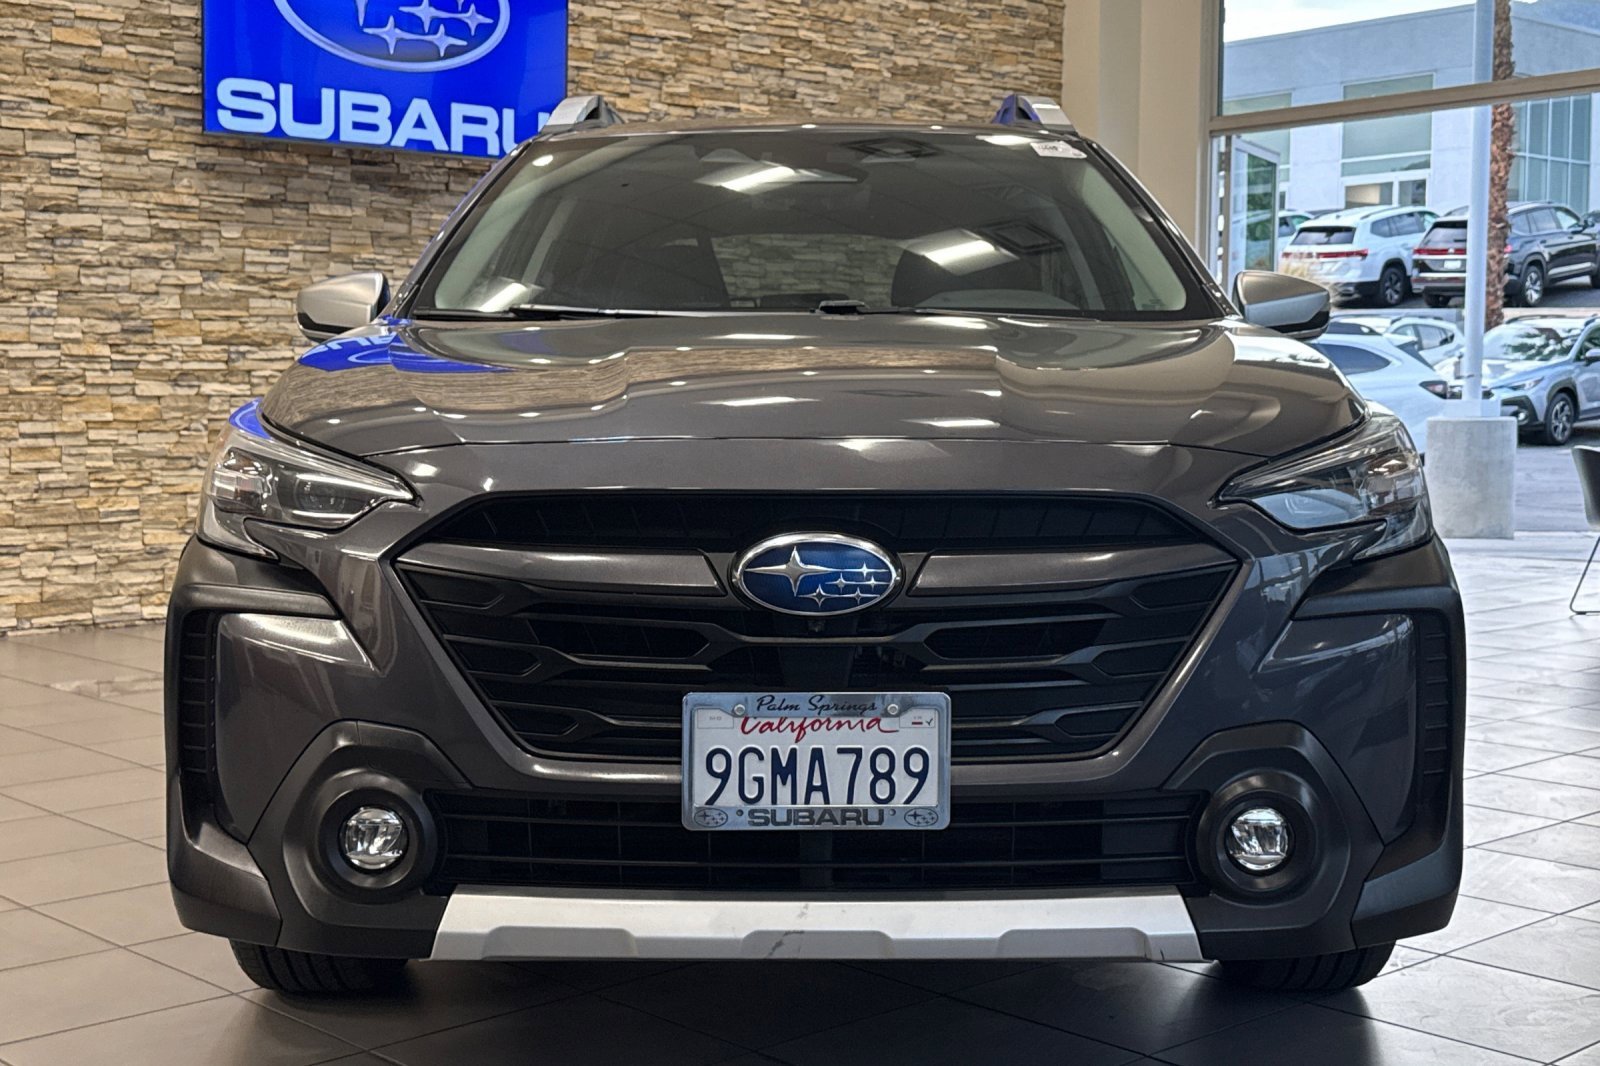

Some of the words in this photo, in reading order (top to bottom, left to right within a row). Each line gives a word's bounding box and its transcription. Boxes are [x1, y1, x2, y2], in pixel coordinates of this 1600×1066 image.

[756, 694, 800, 711] Palm
[808, 694, 877, 715] Springs
[741, 716, 899, 743] California
[704, 746, 930, 806] 9GMA789
[747, 808, 885, 826] SUBARU
